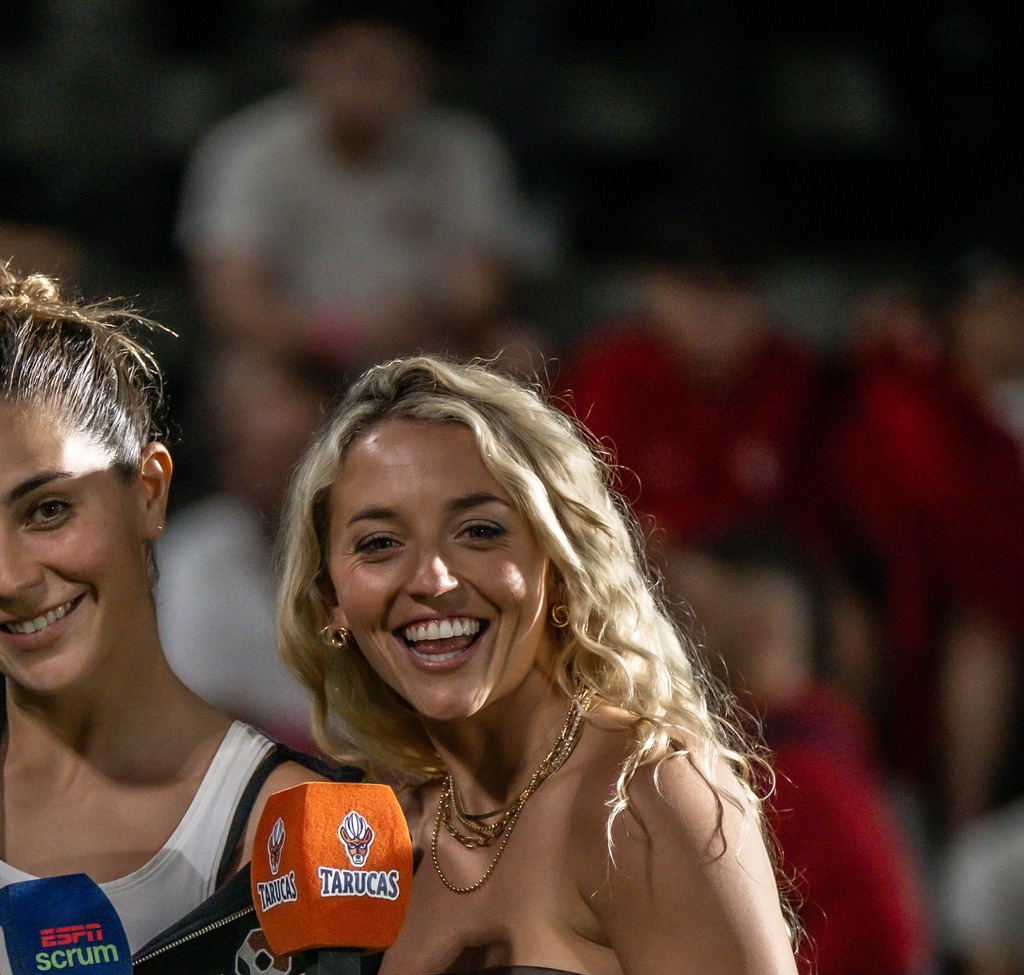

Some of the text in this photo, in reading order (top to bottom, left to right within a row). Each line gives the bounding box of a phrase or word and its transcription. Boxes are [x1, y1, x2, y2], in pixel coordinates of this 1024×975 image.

[257, 870, 298, 912] TARUCAS
[318, 866, 400, 900] TARUCAS
[40, 923, 104, 948] ESPN
[35, 944, 119, 972] scrum
